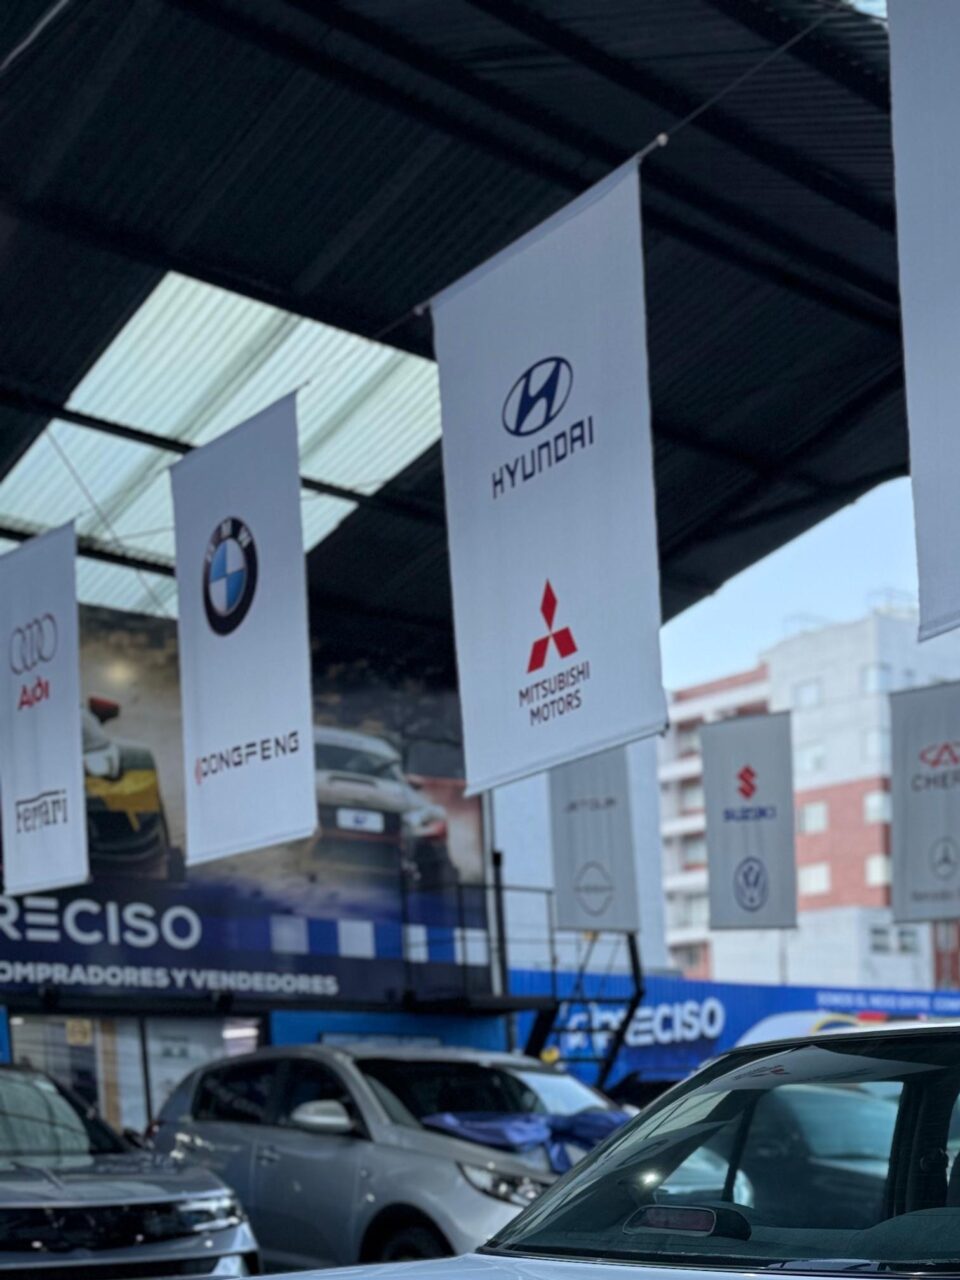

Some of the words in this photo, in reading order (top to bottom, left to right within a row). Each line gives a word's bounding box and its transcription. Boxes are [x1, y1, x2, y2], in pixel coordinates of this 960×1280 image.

[492, 415, 594, 499] HYUNDAI
[519, 660, 590, 707] MITSUBISHI
[530, 688, 582, 726] MOTORS
[173, 969, 191, 987] Y
[191, 969, 338, 995] VENDEDORES
